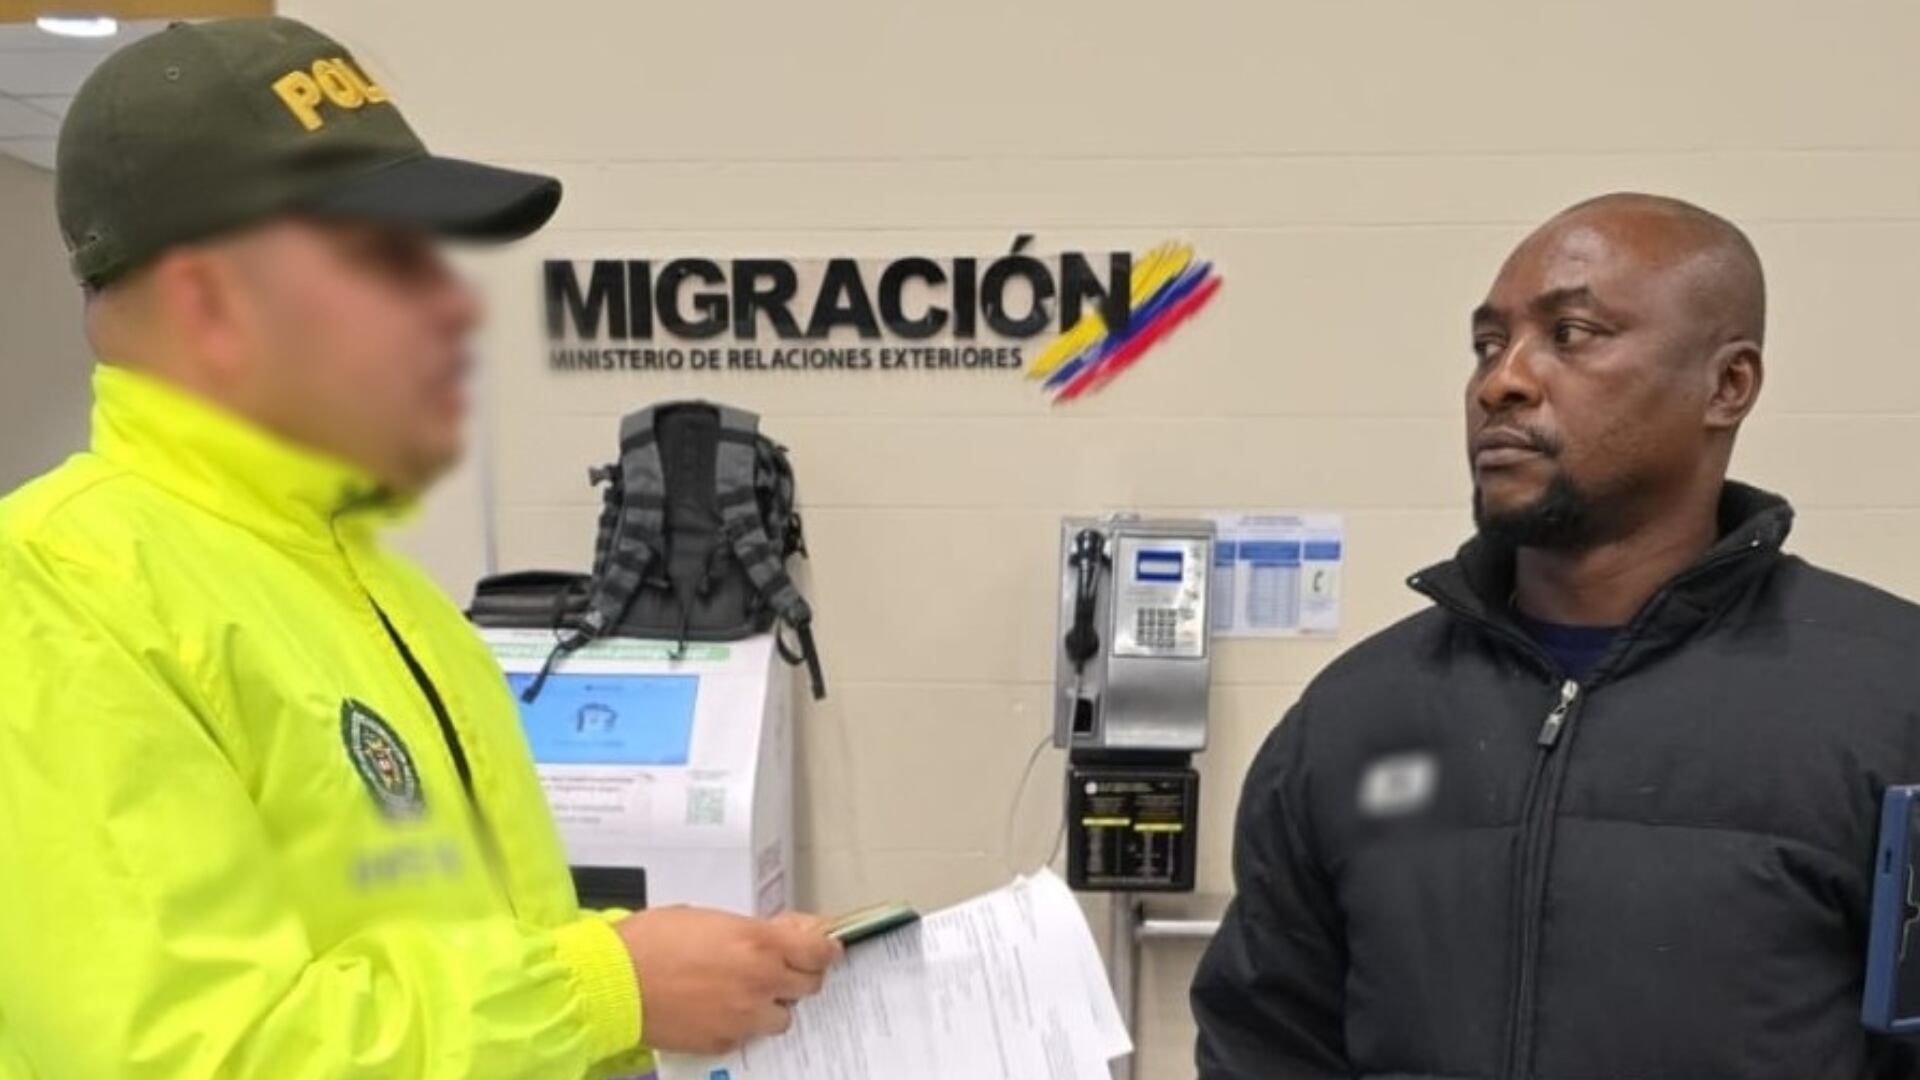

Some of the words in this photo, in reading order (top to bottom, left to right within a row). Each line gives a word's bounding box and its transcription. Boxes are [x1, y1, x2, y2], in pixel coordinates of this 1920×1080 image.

[543, 235, 1132, 340] MIGRACIÓN
[549, 349, 683, 370] MINISTERIO
[689, 349, 721, 369] DE
[727, 348, 871, 370] RELACIONES
[879, 347, 1022, 369] EXTERIORES
